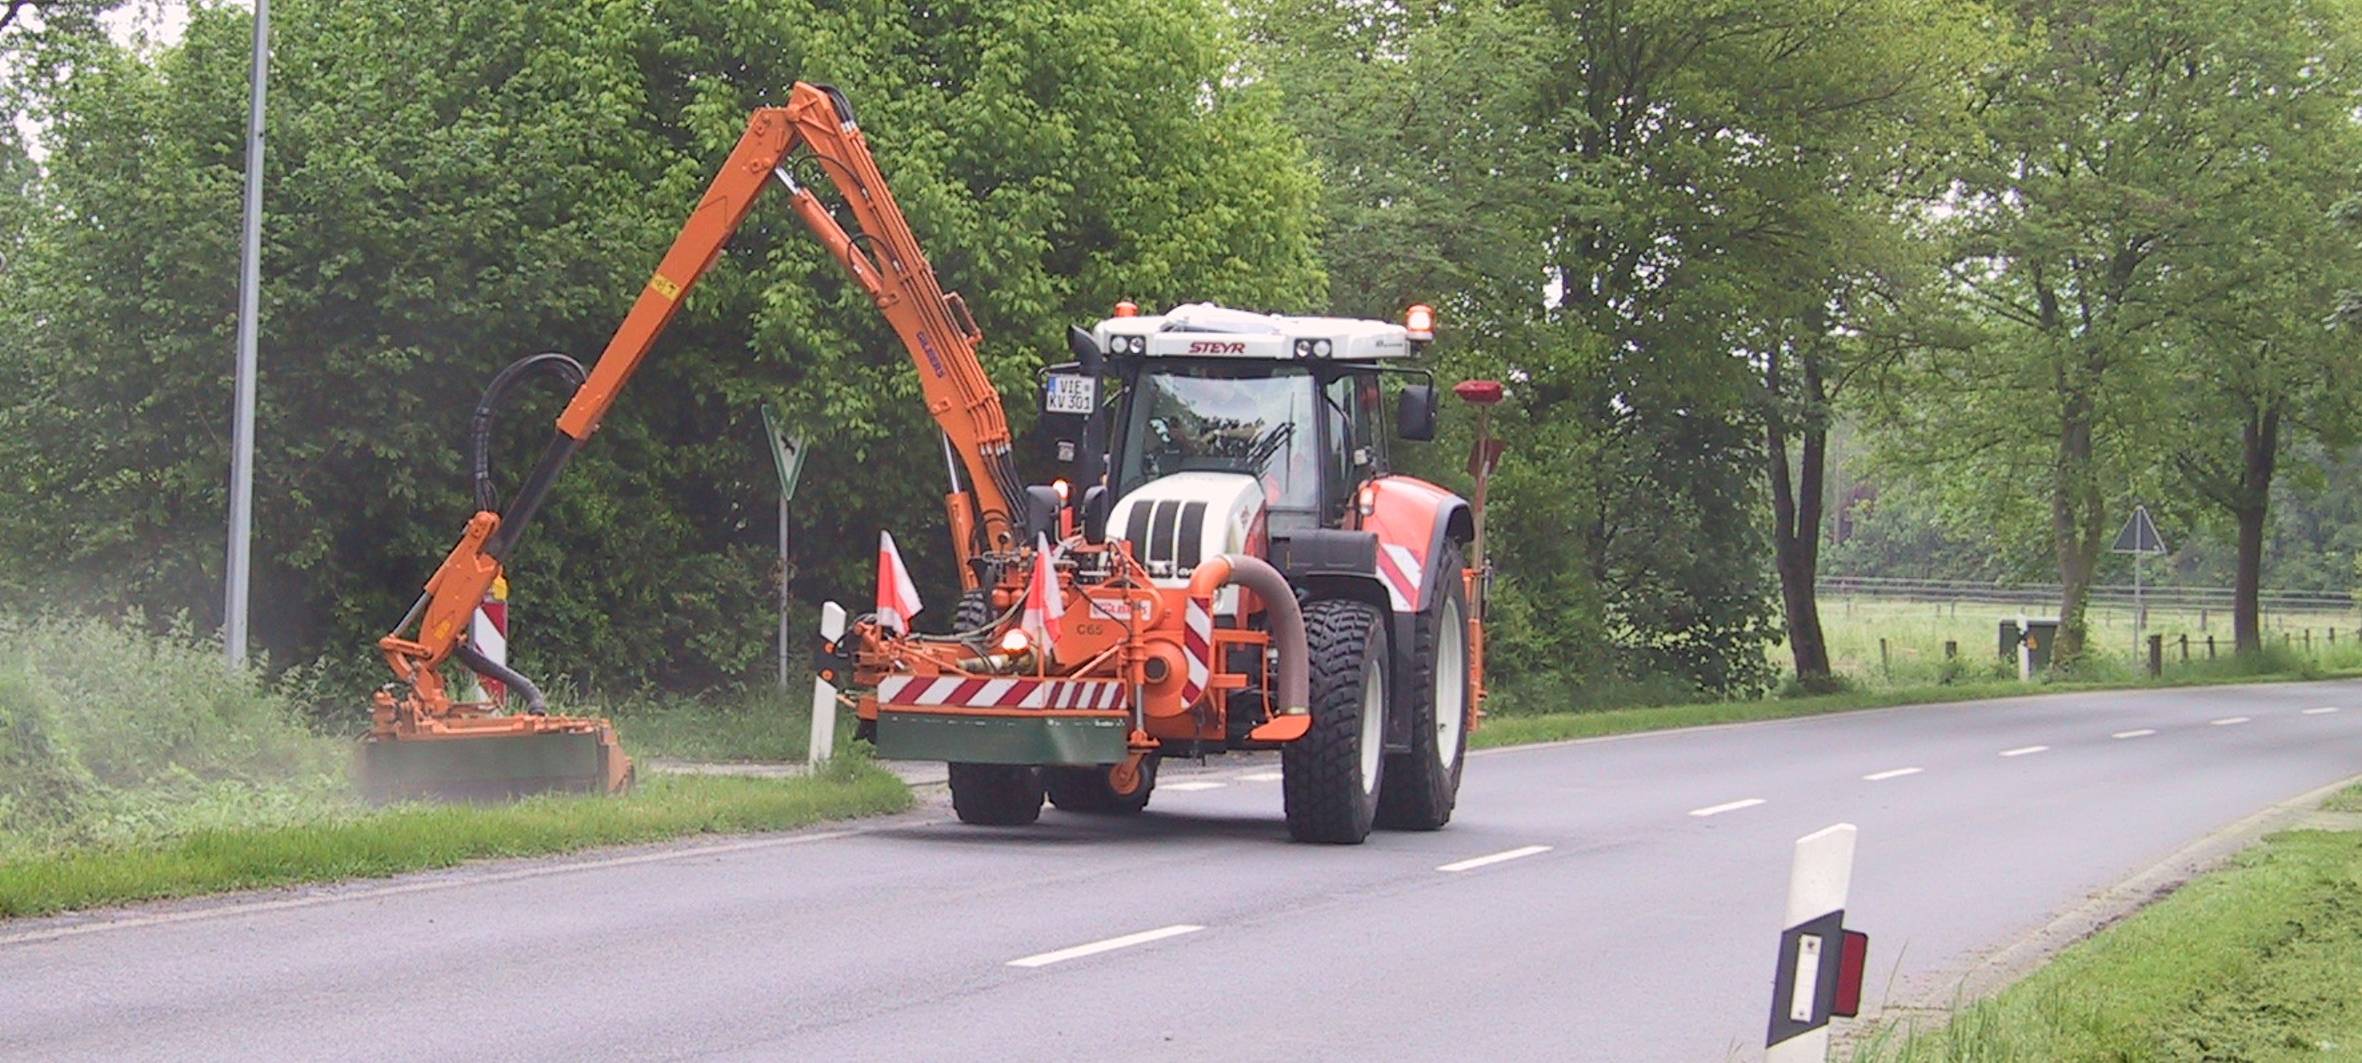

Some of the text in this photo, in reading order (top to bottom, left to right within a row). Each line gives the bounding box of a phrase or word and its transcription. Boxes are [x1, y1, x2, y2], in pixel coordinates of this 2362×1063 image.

[1188, 341, 1246, 354] STEYR
[1060, 380, 1082, 394] VIE
[1049, 395, 1090, 409] KV 301
